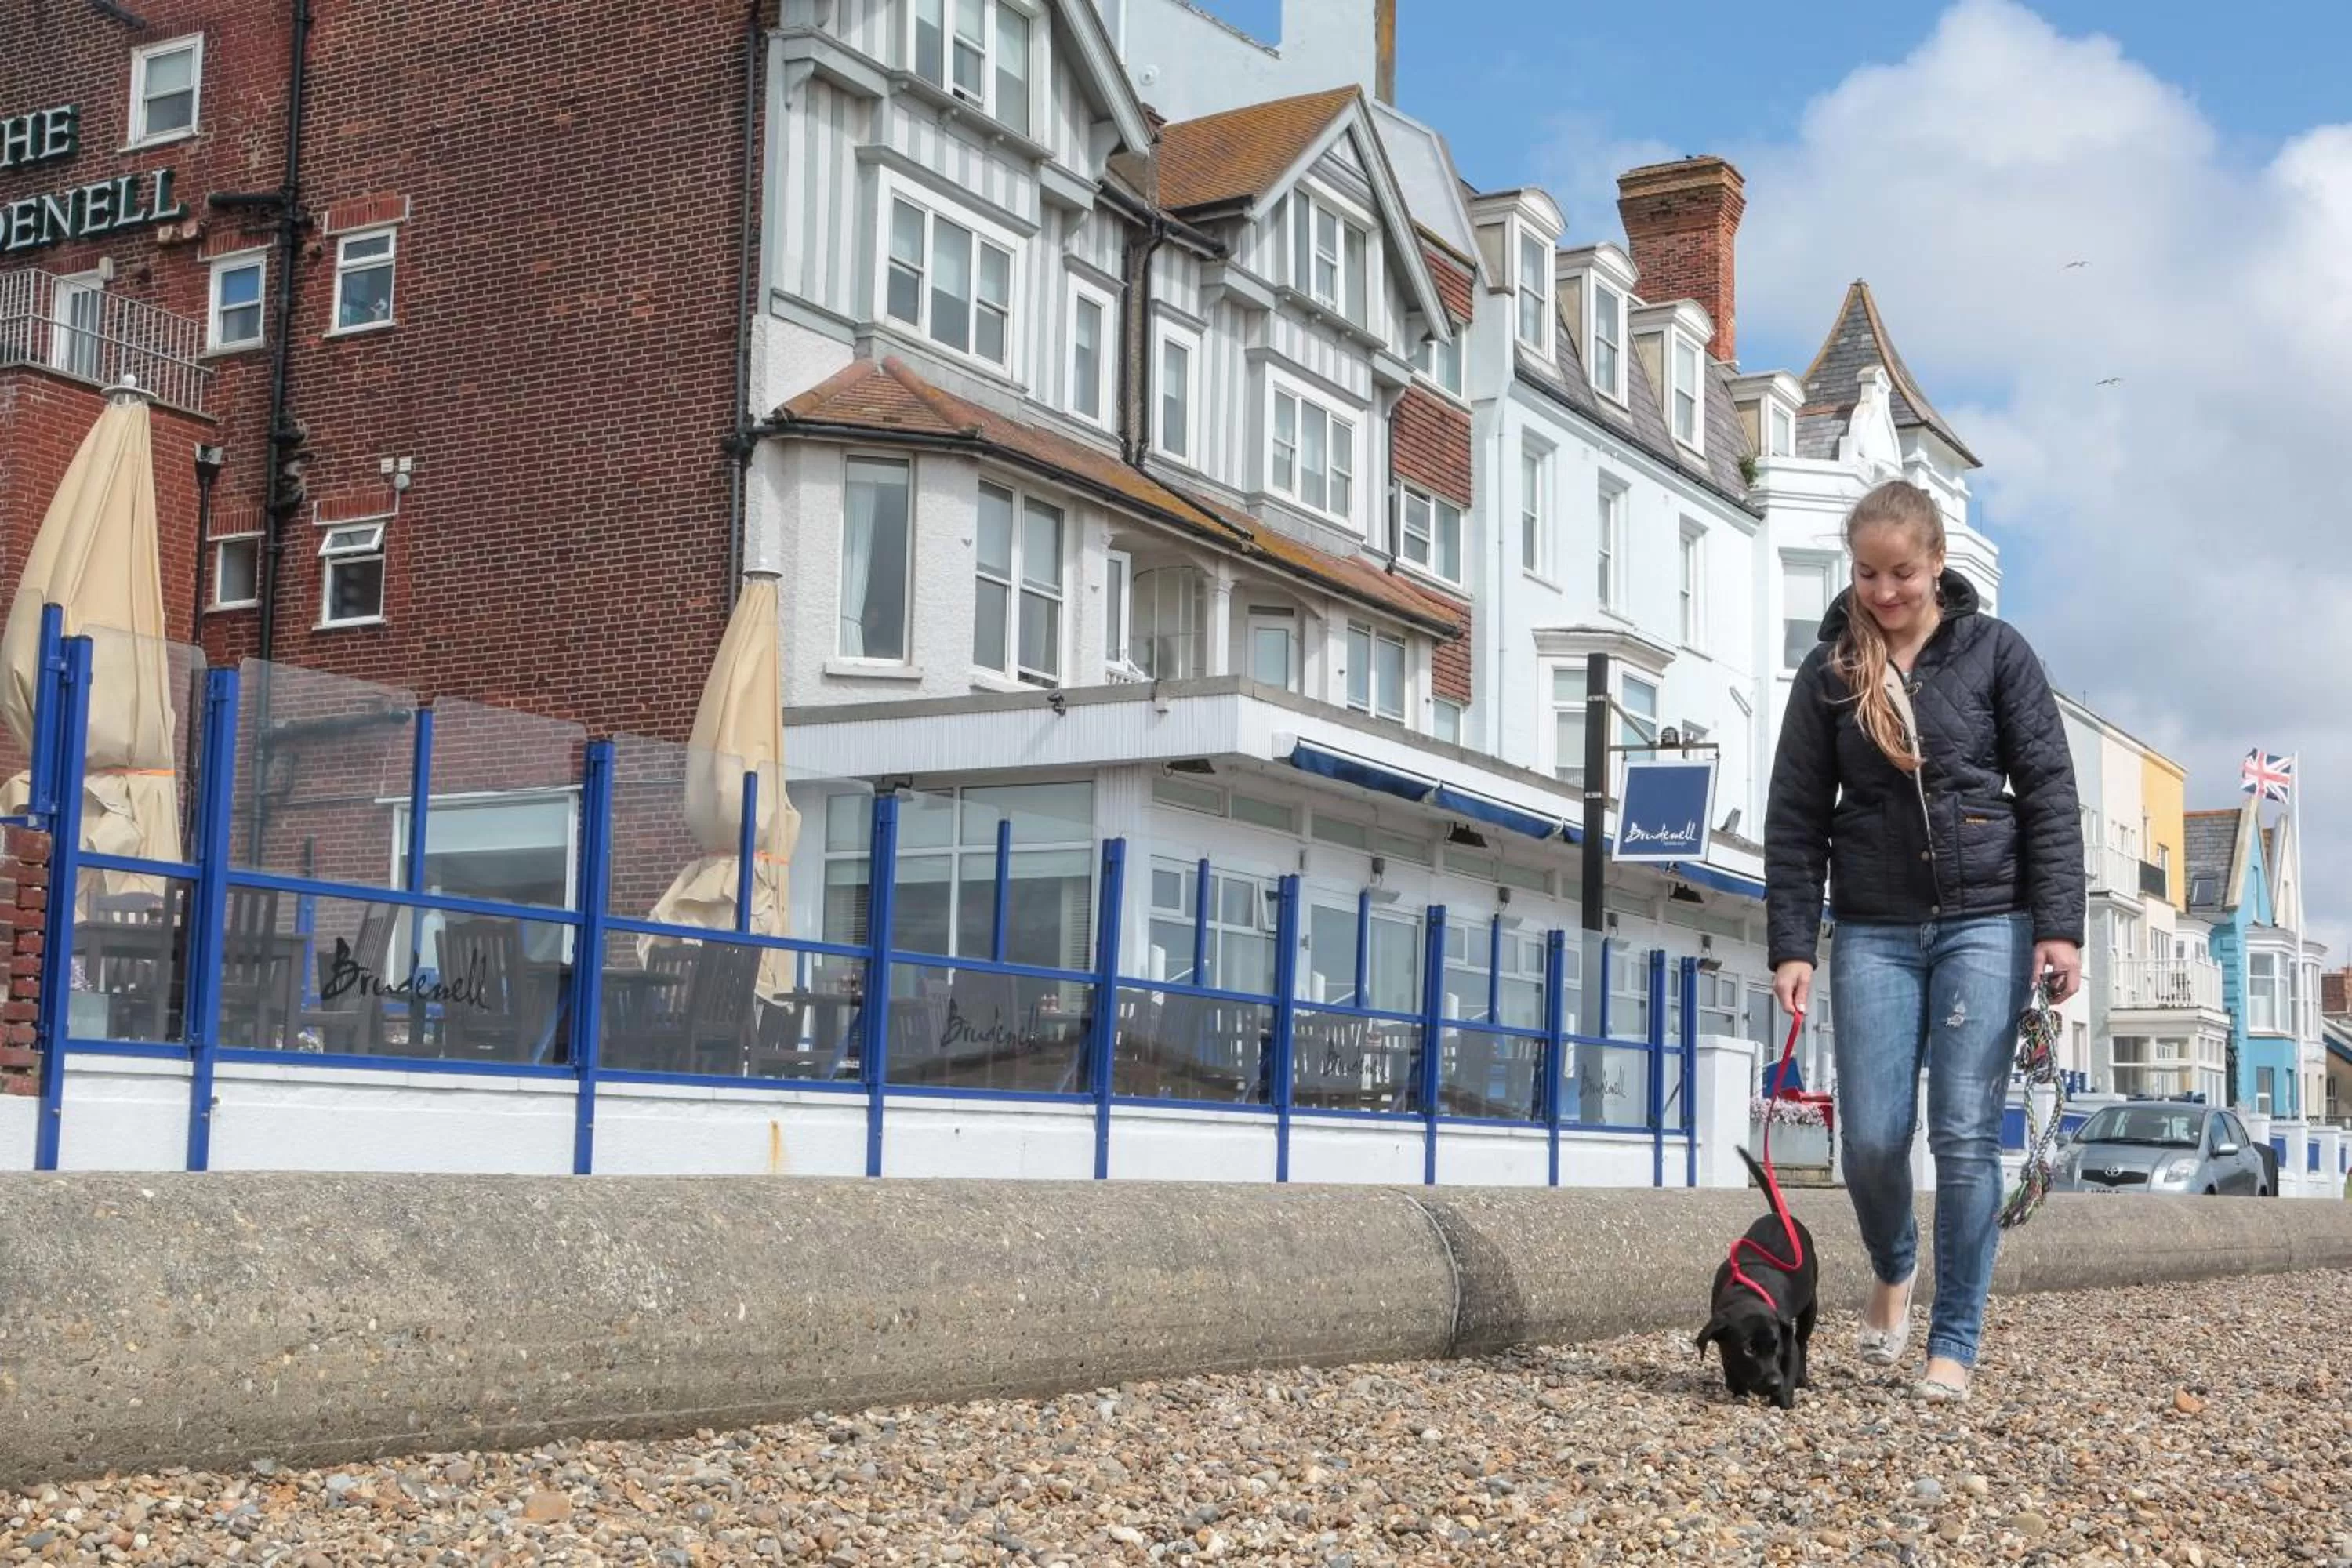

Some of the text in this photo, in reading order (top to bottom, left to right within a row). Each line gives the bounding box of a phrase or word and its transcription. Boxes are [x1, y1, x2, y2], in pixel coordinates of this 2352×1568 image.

[1624, 819, 1697, 843] Brudenell
[321, 936, 489, 1009] Brudenell
[941, 997, 1042, 1051] Brudenell
